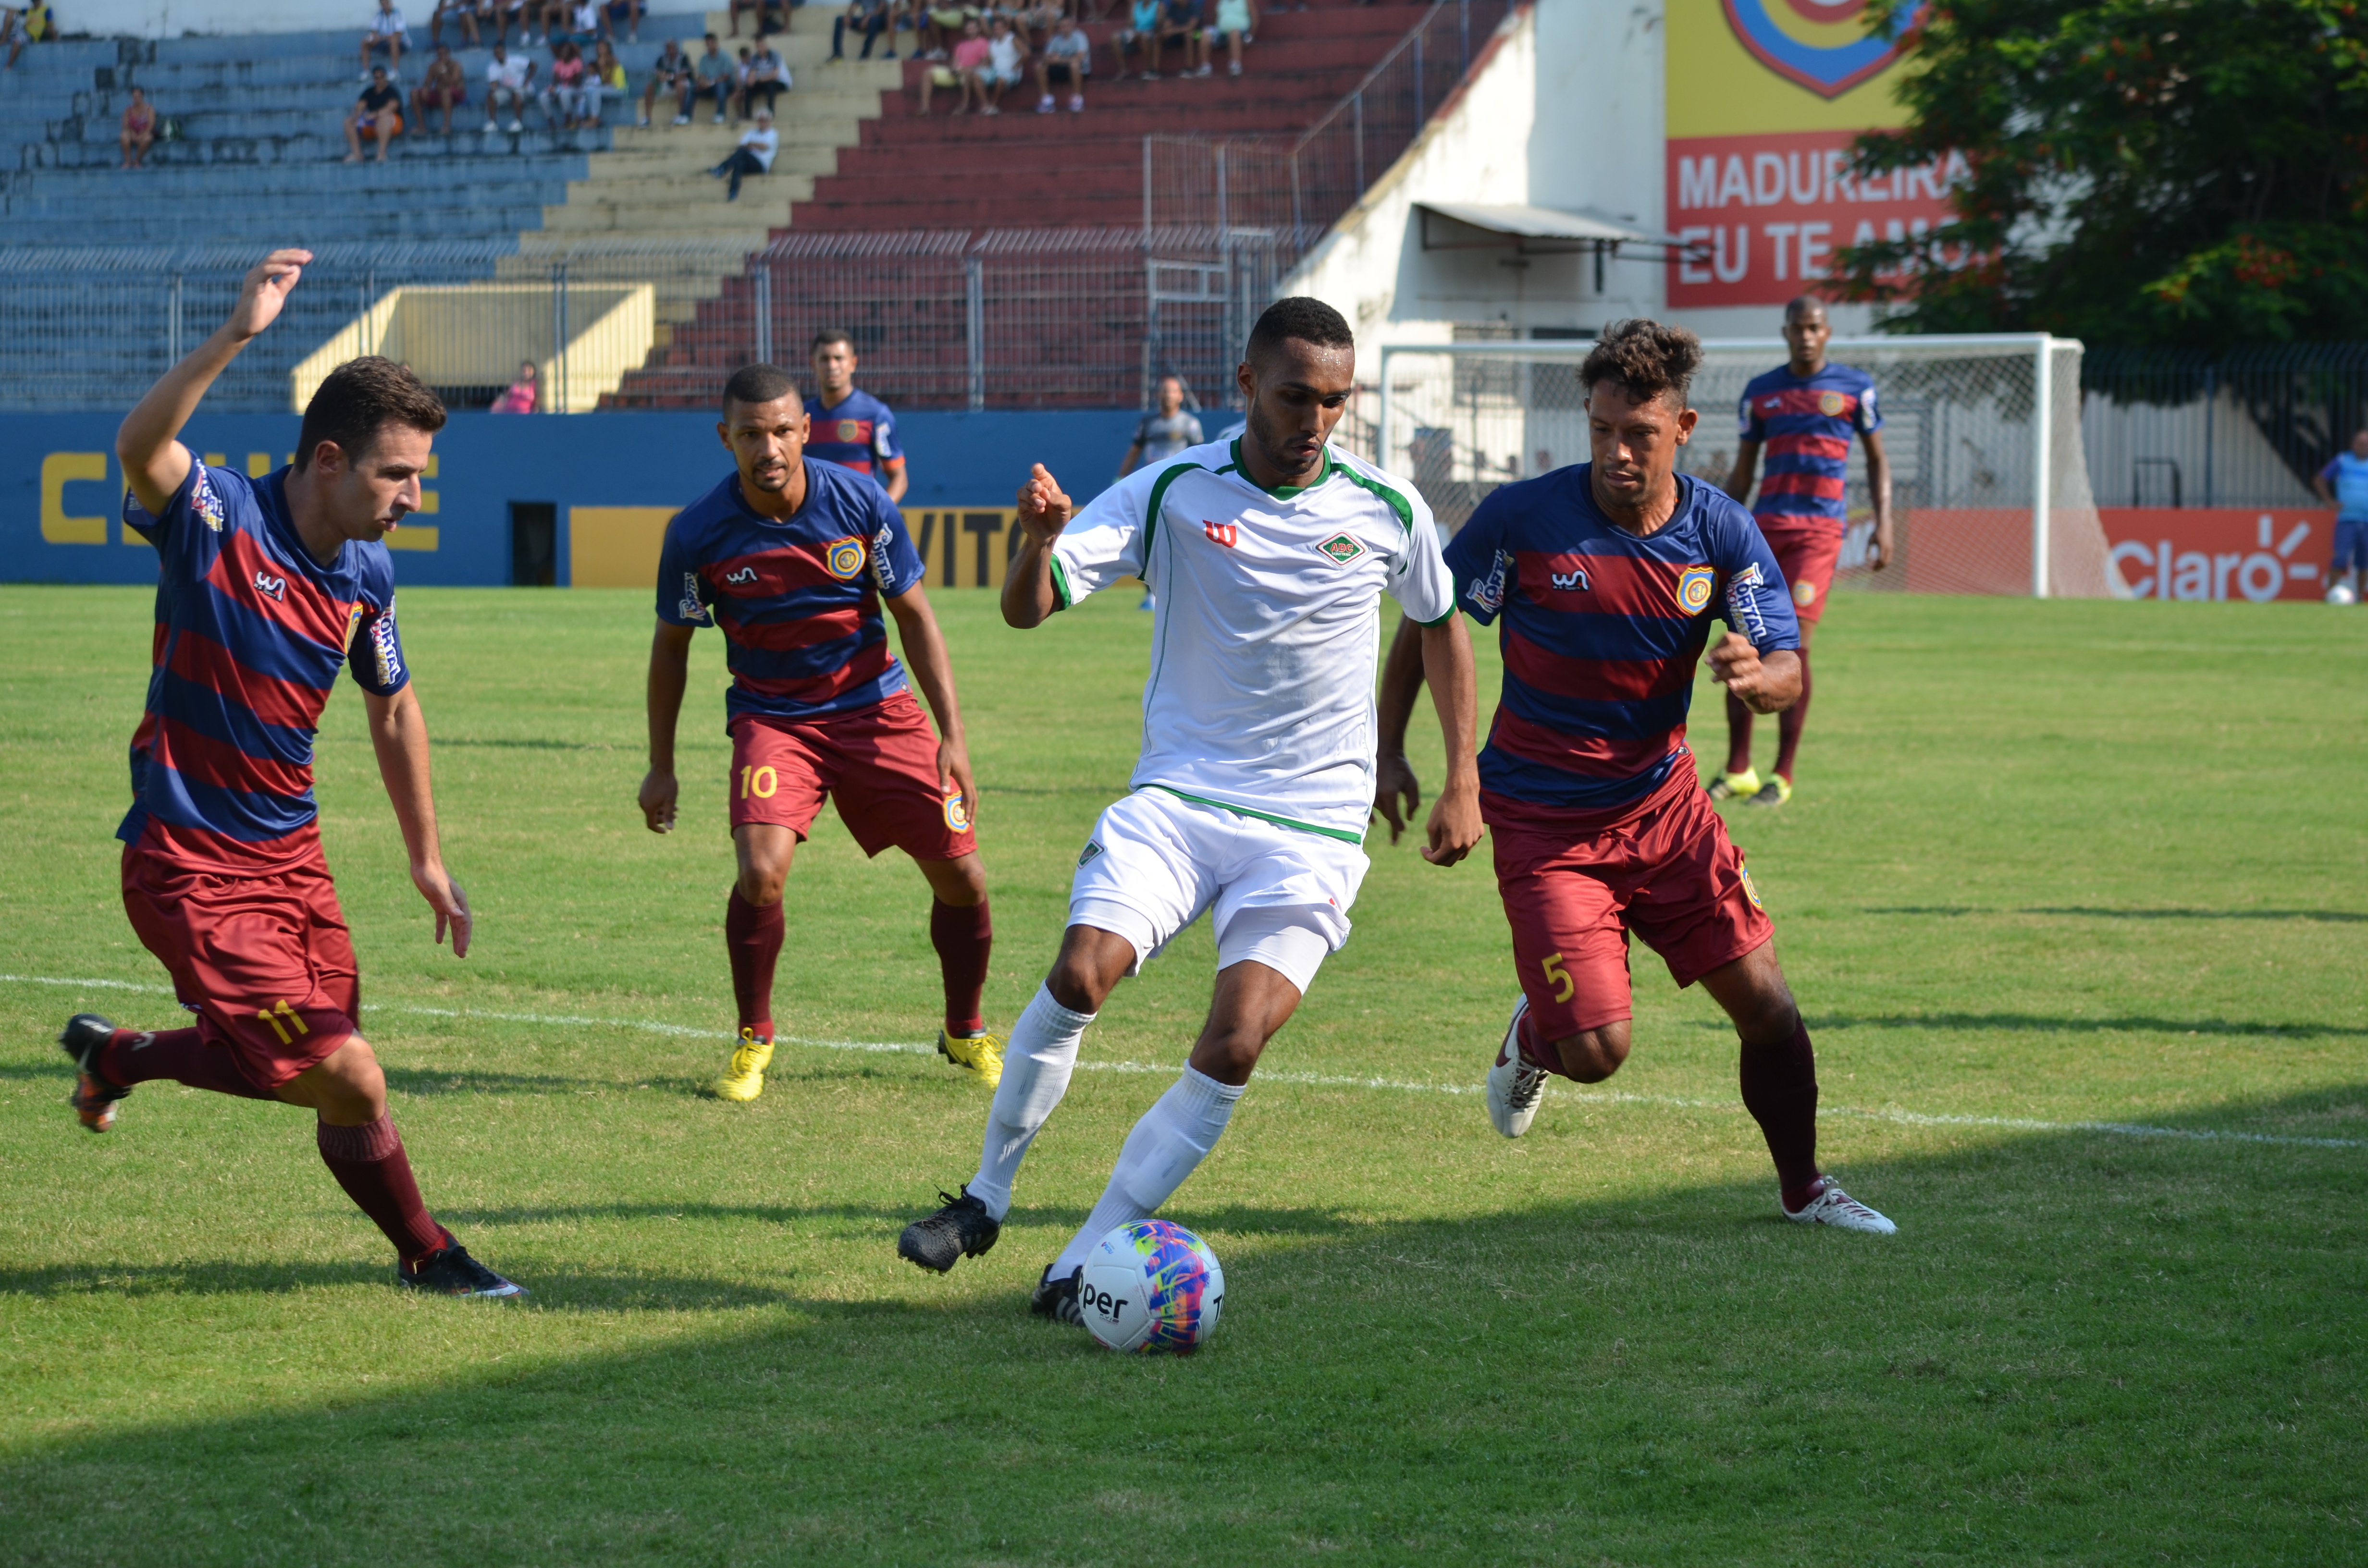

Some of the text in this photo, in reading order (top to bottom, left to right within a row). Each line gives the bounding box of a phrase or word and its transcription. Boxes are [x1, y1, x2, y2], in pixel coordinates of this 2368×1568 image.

[1679, 225, 1749, 284] EU
[1764, 220, 1832, 281] TE
[1331, 542, 1354, 553] ADC
[2104, 539, 2283, 602] Claro
[740, 765, 777, 799] 10
[1542, 952, 1574, 1003] 5
[258, 999, 309, 1044] 11
